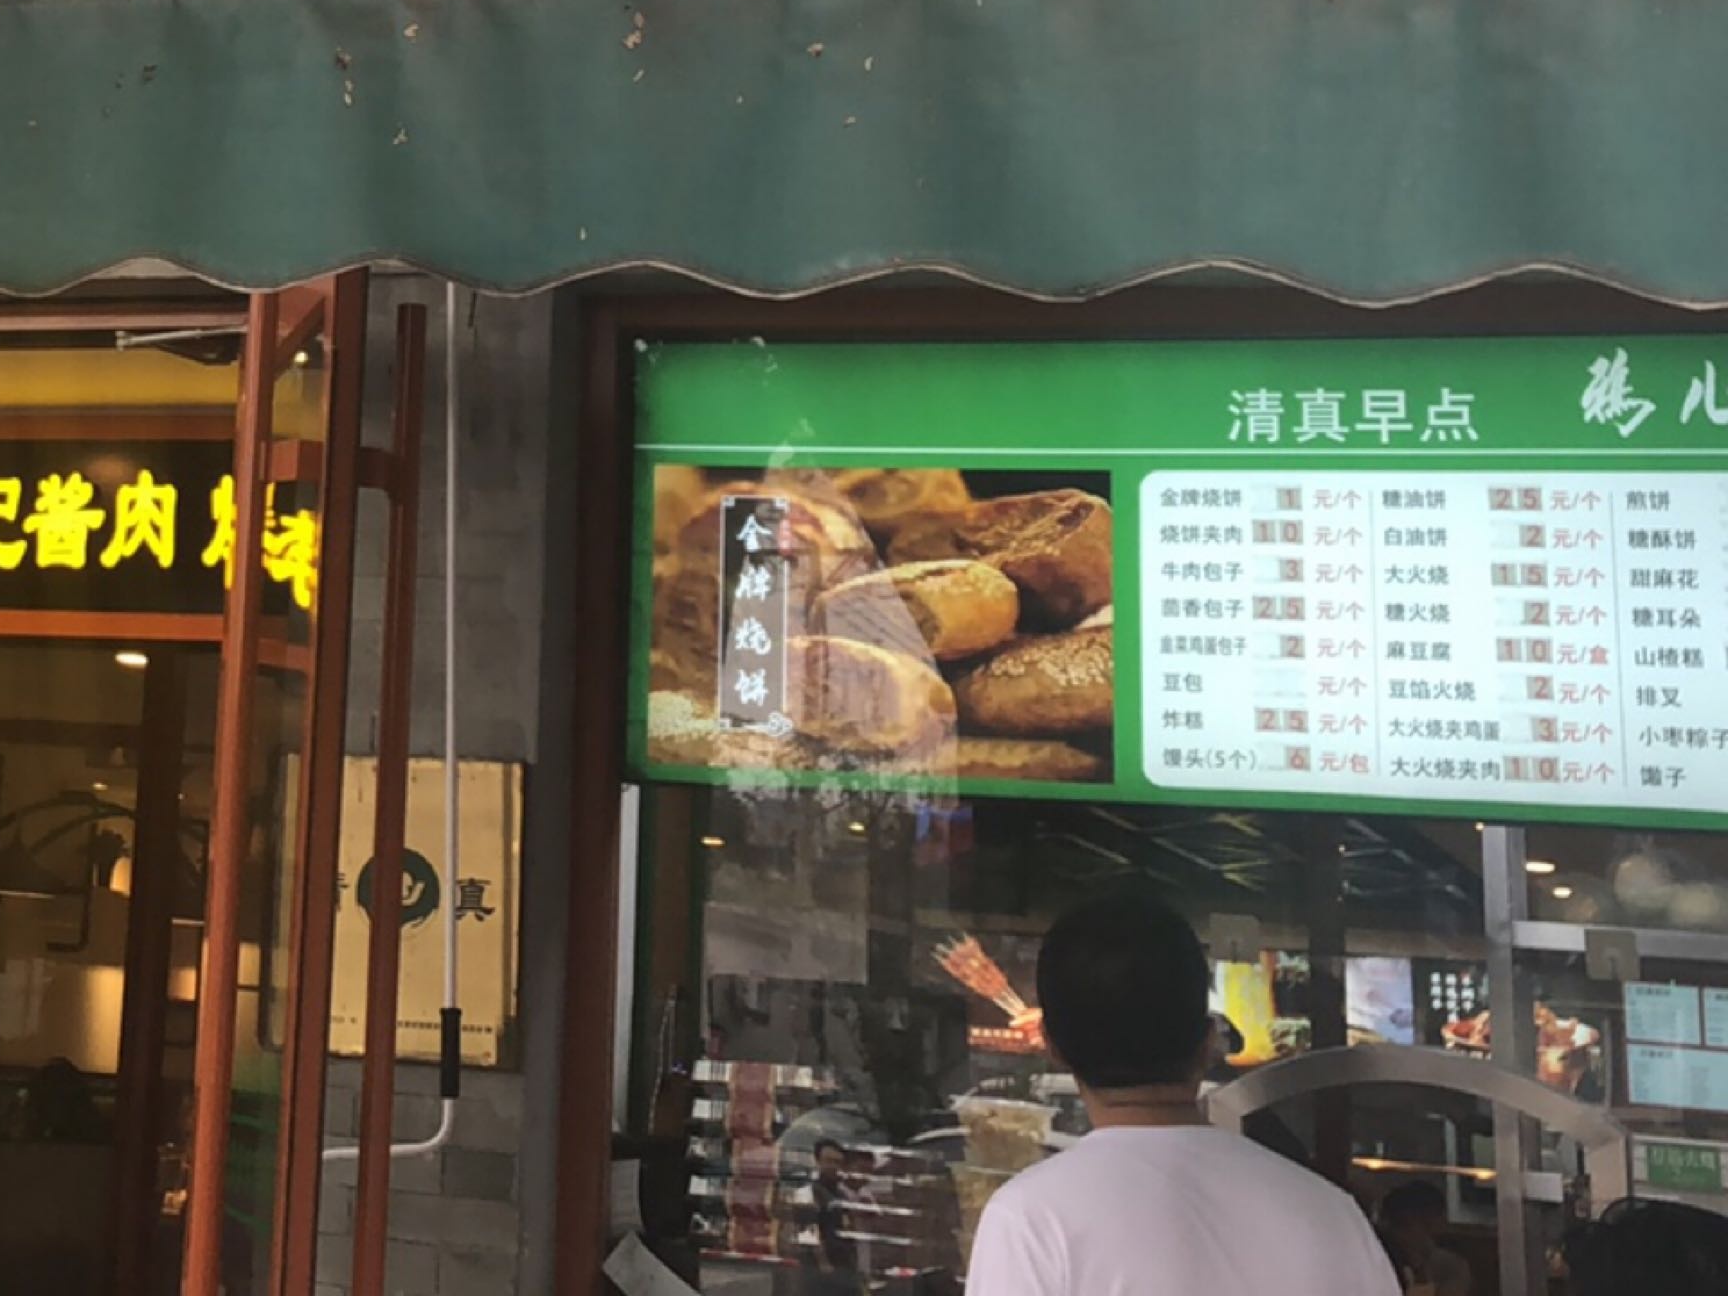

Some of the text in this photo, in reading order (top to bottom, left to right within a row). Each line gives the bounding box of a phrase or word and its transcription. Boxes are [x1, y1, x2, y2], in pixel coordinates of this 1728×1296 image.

[1228, 387, 1479, 444] 清真早点
[1160, 487, 1242, 508] 金牌烧饼
[1160, 524, 1244, 544] 烧饼夹肉
[1384, 527, 1447, 547] 白油饼
[1161, 561, 1244, 582] 牛肉包子
[1384, 564, 1450, 585] 大火烧
[733, 513, 773, 707] 金牌烧饼
[1162, 672, 1203, 693] 豆包
